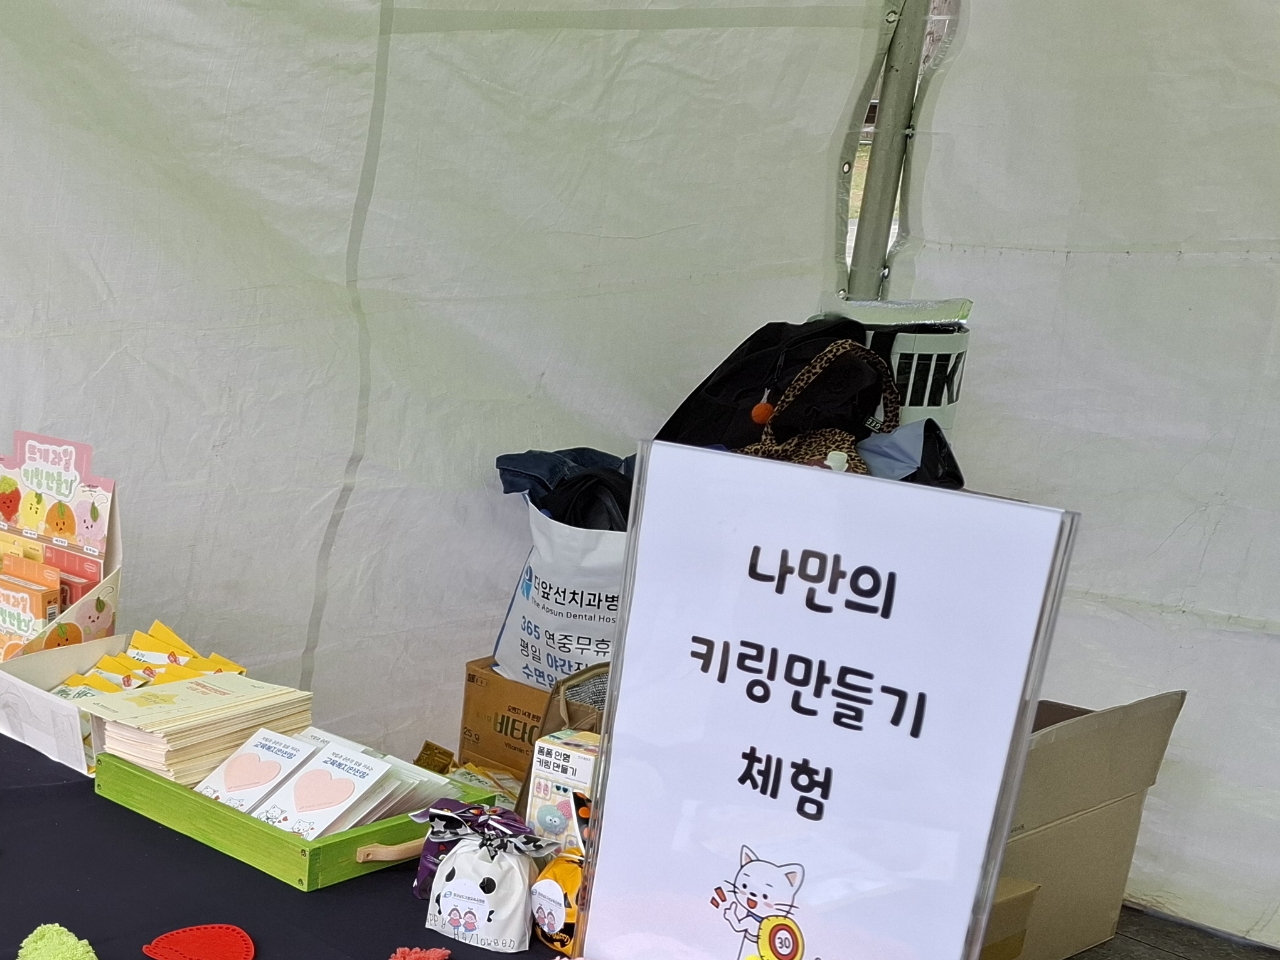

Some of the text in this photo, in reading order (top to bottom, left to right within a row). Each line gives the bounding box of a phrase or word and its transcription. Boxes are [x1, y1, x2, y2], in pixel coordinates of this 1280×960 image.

[748, 545, 897, 619] 나만의
[566, 611, 596, 622] Dental
[521, 615, 612, 658] 365 연중무휴
[519, 638, 541, 664] 평일
[690, 635, 927, 739] 키링만들기
[536, 757, 577, 777] 키링 만들기
[554, 751, 570, 763] 인형
[737, 745, 833, 821] 체험
[777, 936, 791, 949] 30
